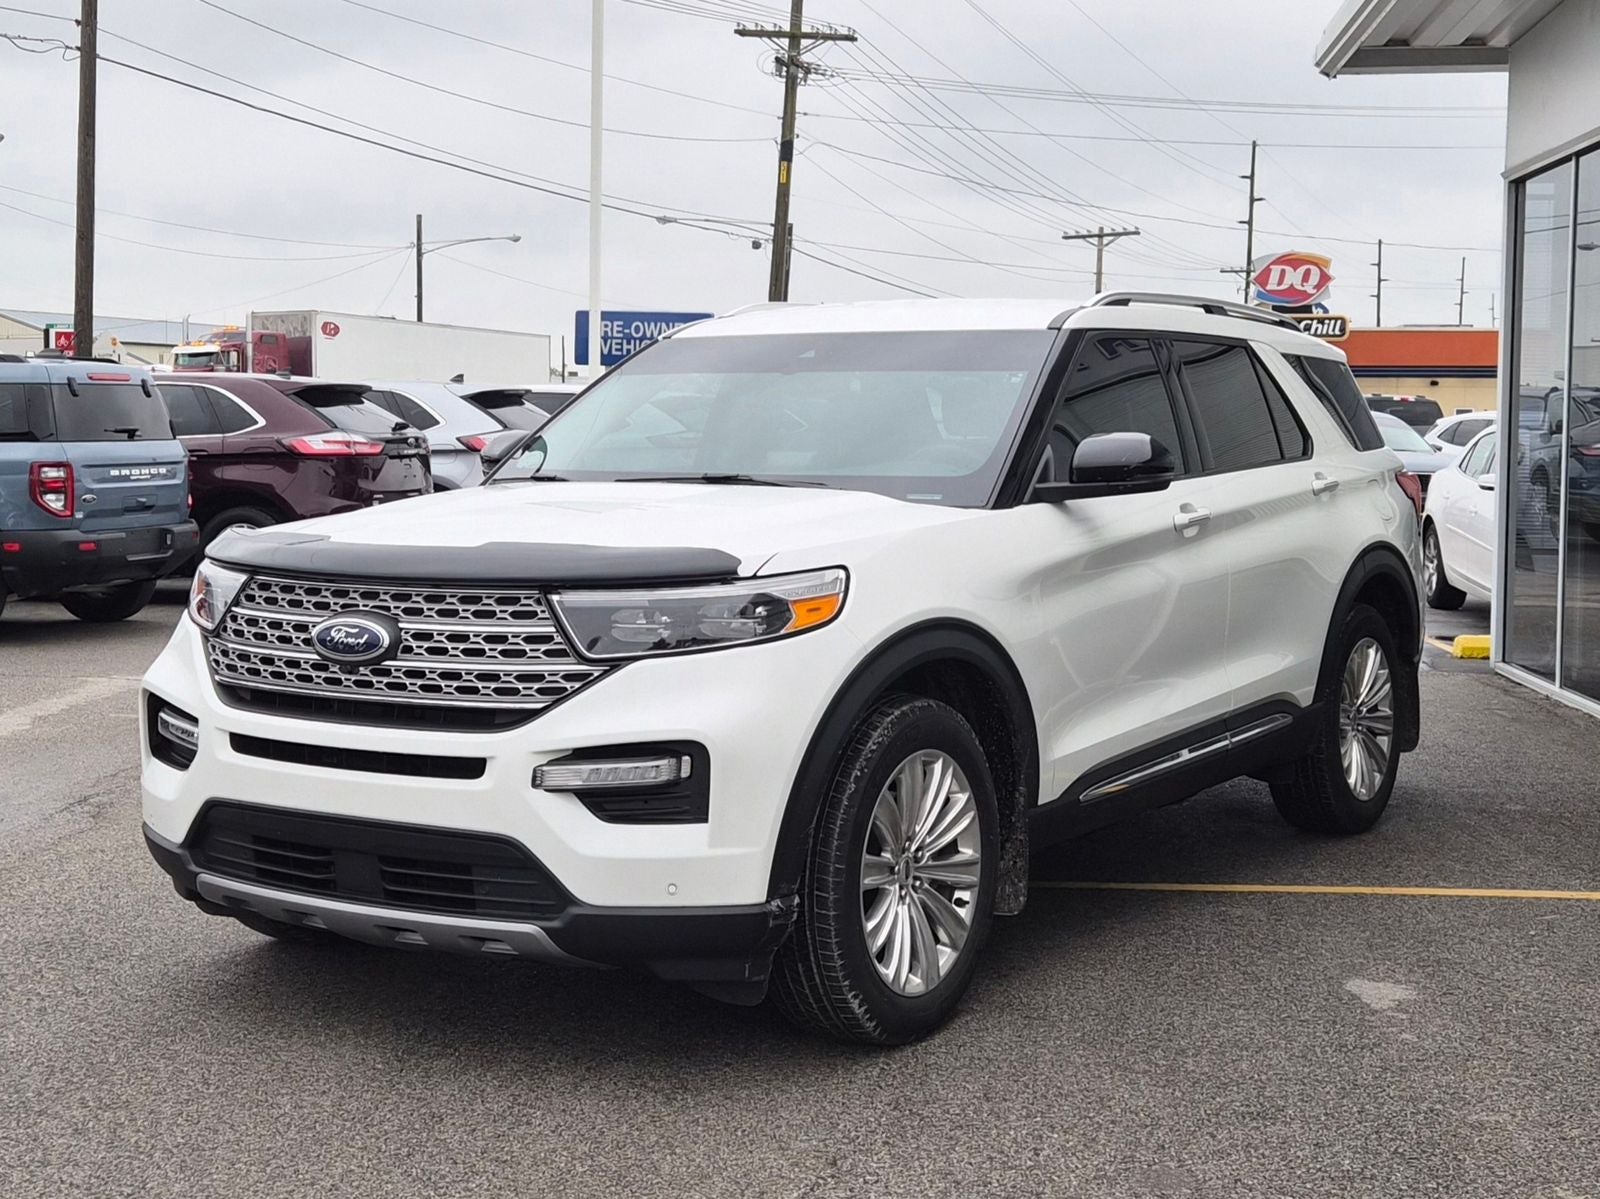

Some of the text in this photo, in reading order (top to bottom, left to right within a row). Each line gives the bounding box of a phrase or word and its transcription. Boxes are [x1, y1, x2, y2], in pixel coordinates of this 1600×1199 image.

[1266, 265, 1320, 294] DQ
[1300, 319, 1341, 335] Chill
[326, 626, 368, 650] Ford
